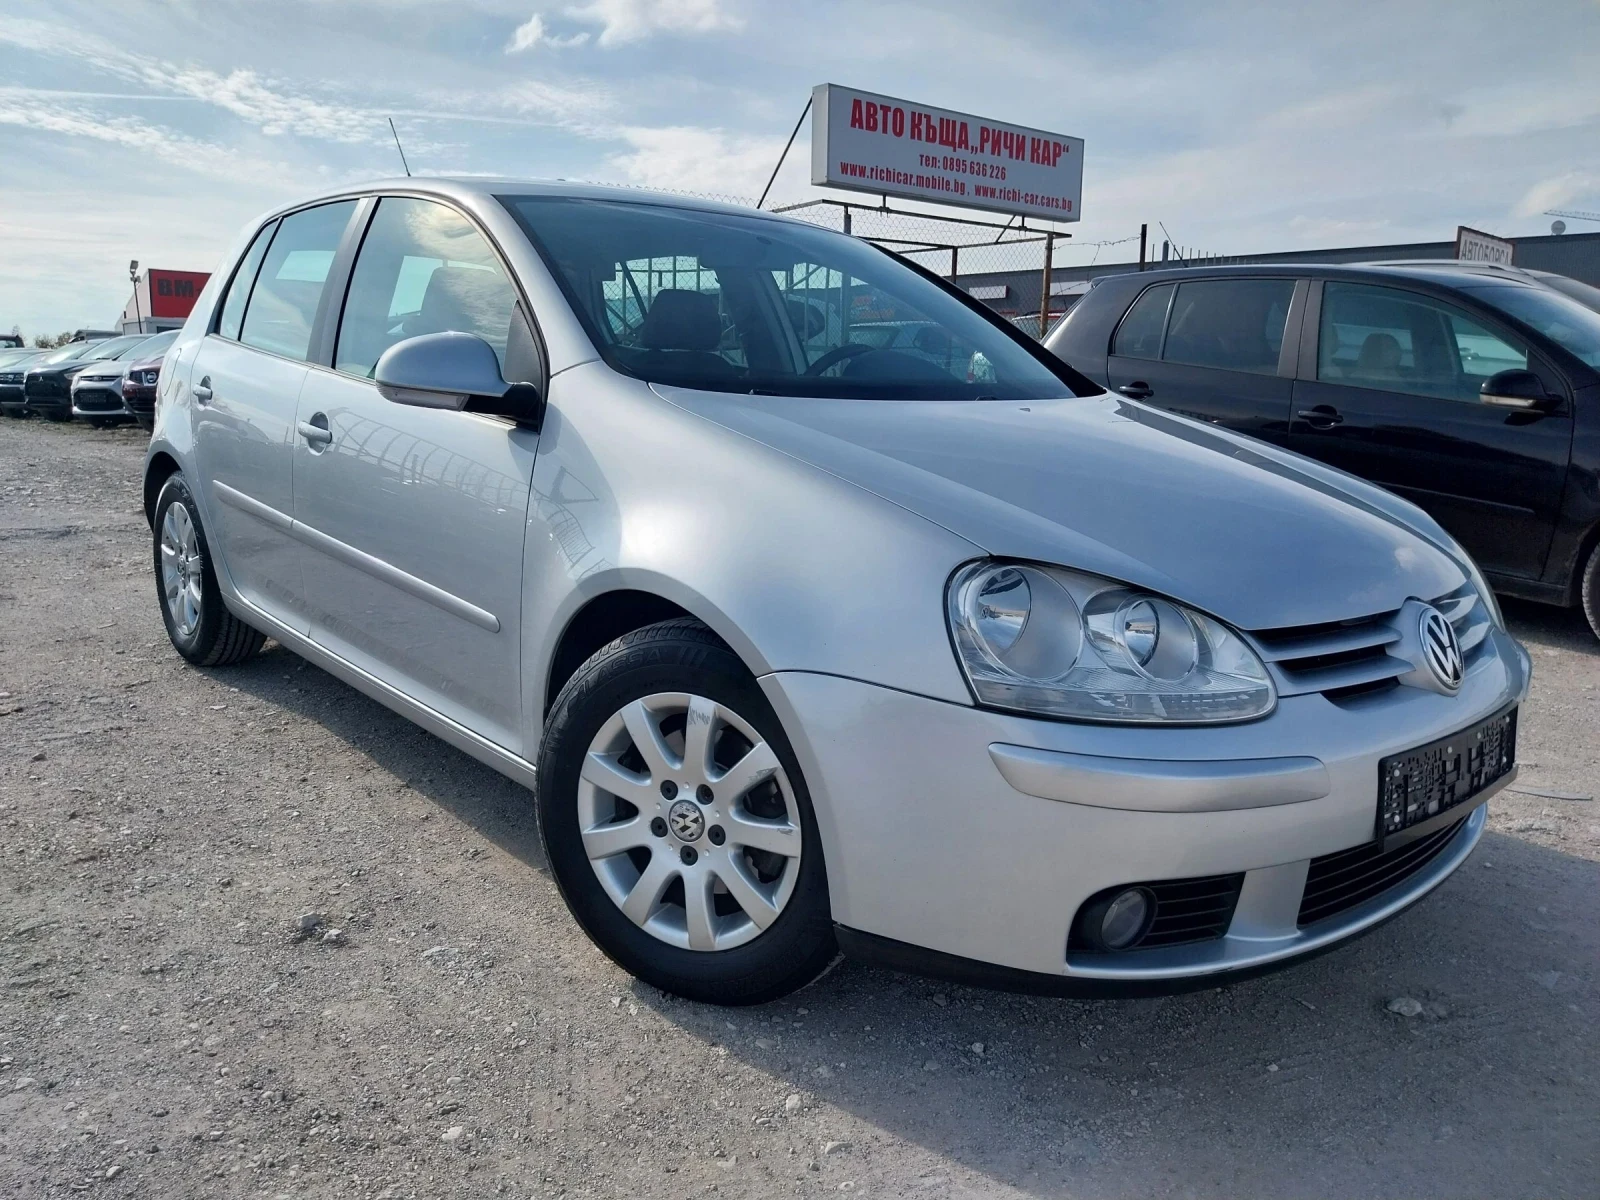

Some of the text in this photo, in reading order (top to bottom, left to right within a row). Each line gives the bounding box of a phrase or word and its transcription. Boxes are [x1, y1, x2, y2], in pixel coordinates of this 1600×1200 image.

[850, 98, 905, 138] АВТО
[919, 154, 1007, 181] тел: 0895 636 226
[974, 184, 1073, 212] www.richi-car.cars.bg
